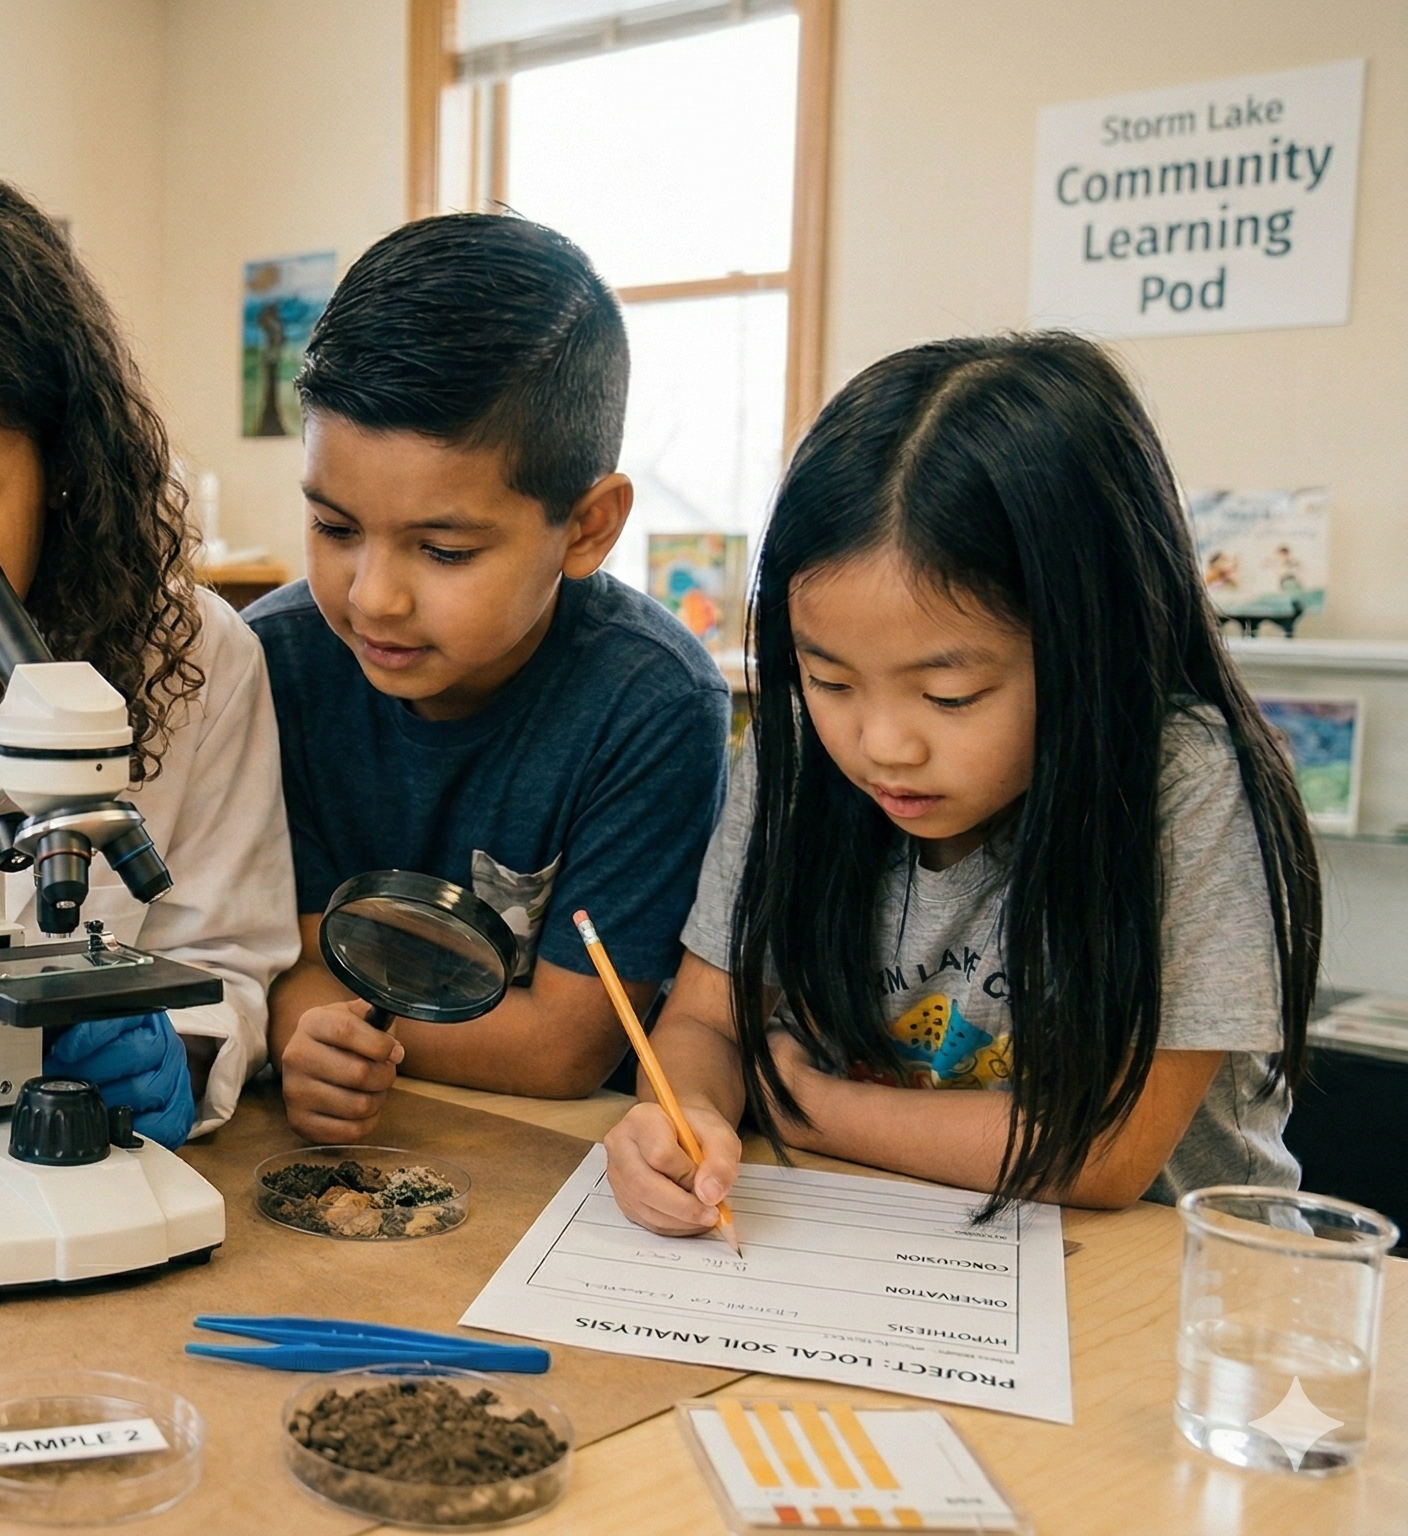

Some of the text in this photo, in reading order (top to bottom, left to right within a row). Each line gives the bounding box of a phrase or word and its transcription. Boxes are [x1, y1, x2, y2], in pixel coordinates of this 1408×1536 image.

[1102, 95, 1284, 146] Storm Lake
[1056, 137, 1333, 208] Community
[1083, 205, 1295, 263] Learning
[1140, 265, 1227, 315] Pod
[719, 1335, 778, 1354] SOIL
[786, 1345, 873, 1367] LOCAL
[883, 1359, 1016, 1389] PROJECT:
[125, 1429, 140, 1441] 2
